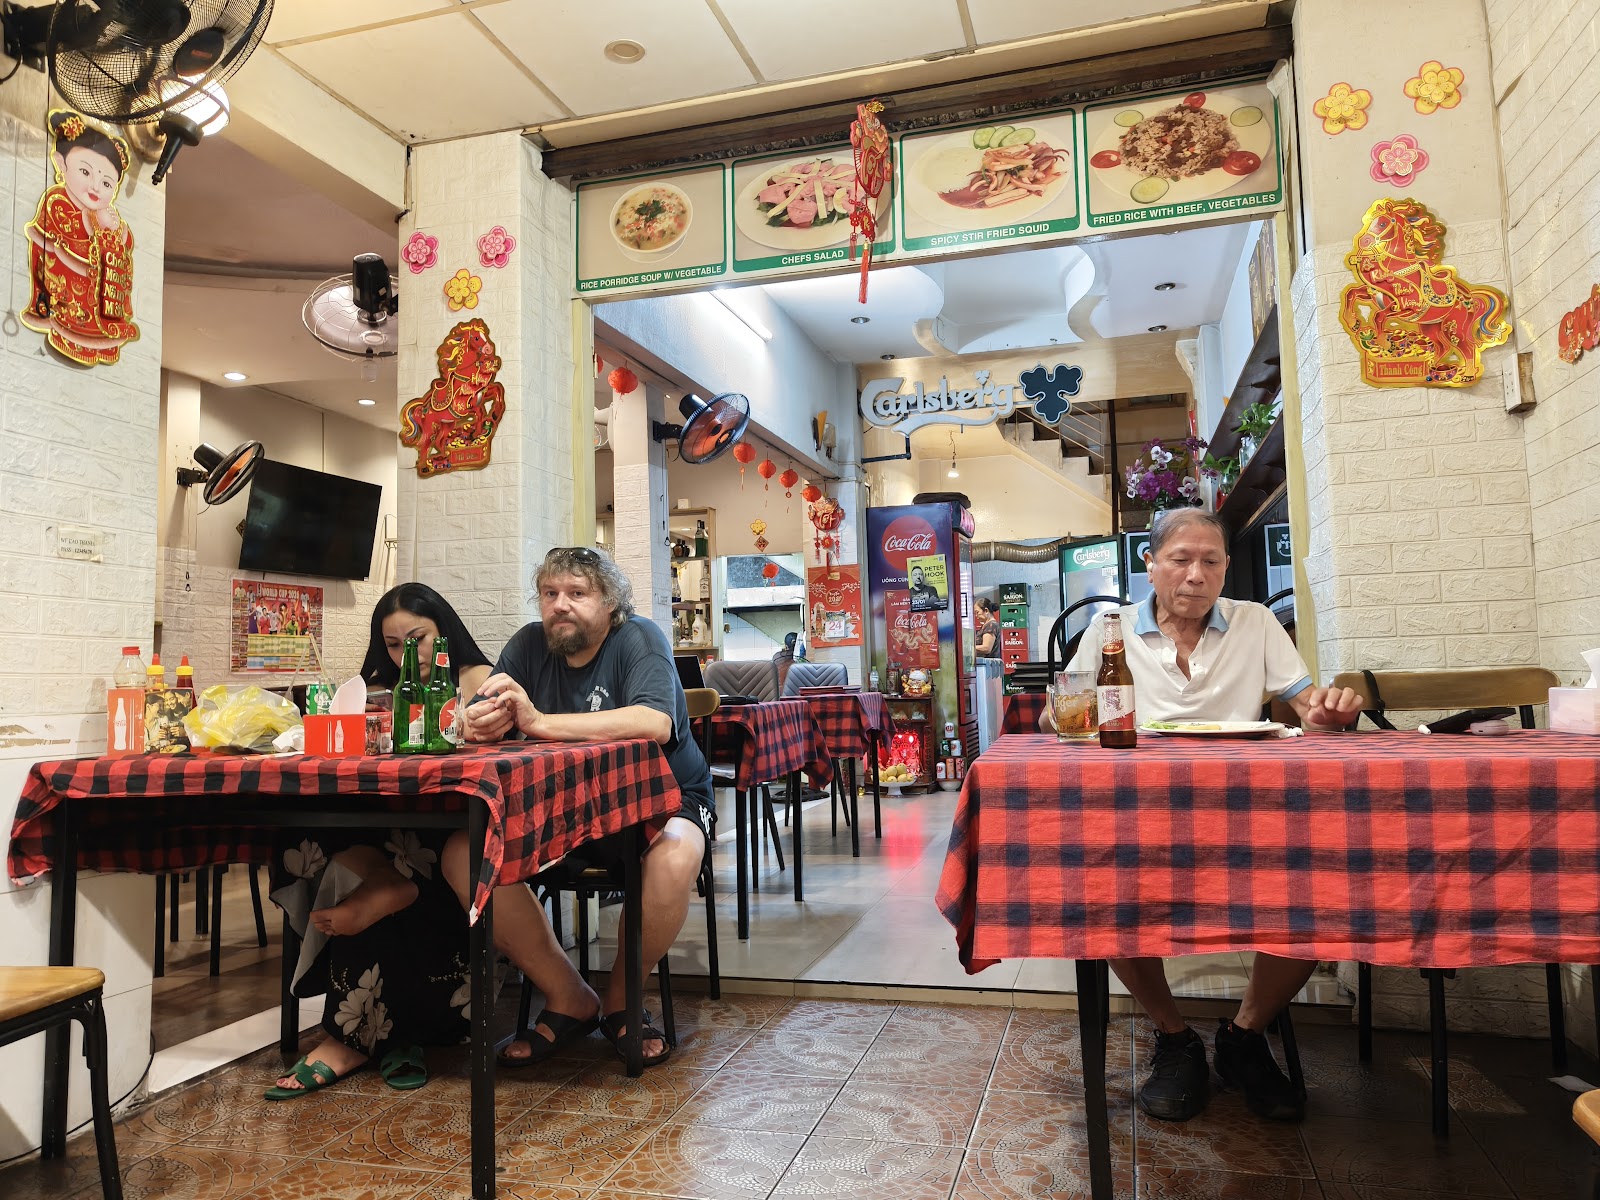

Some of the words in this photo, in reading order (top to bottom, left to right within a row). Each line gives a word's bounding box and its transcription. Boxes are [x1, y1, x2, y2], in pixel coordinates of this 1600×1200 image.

[1093, 214, 1122, 226] FRIED
[1124, 211, 1147, 220] RICE
[1149, 207, 1174, 218] WITH
[1176, 203, 1206, 214] BEEF,
[1207, 193, 1277, 211] VEGETABLES
[930, 234, 960, 247] SPICY
[962, 231, 984, 243] STIR
[986, 227, 1016, 239] FRIED
[1018, 223, 1051, 235] SQUID
[781, 254, 812, 265] CHEFS
[814, 250, 845, 261] SALAD
[580, 280, 599, 290] RICE
[600, 275, 640, 287] PORRIDGE
[641, 272, 662, 283] SOUP
[663, 271, 674, 280] W/
[675, 265, 722, 279] VEGETABLE
[104, 282, 125, 303] Năm
[860, 374, 1015, 434] Carlsberg
[884, 533, 934, 552] Coca-Cola
[1073, 546, 1110, 565] Carlsberg
[924, 564, 944, 572] PETER
[828, 621, 843, 631] 24
